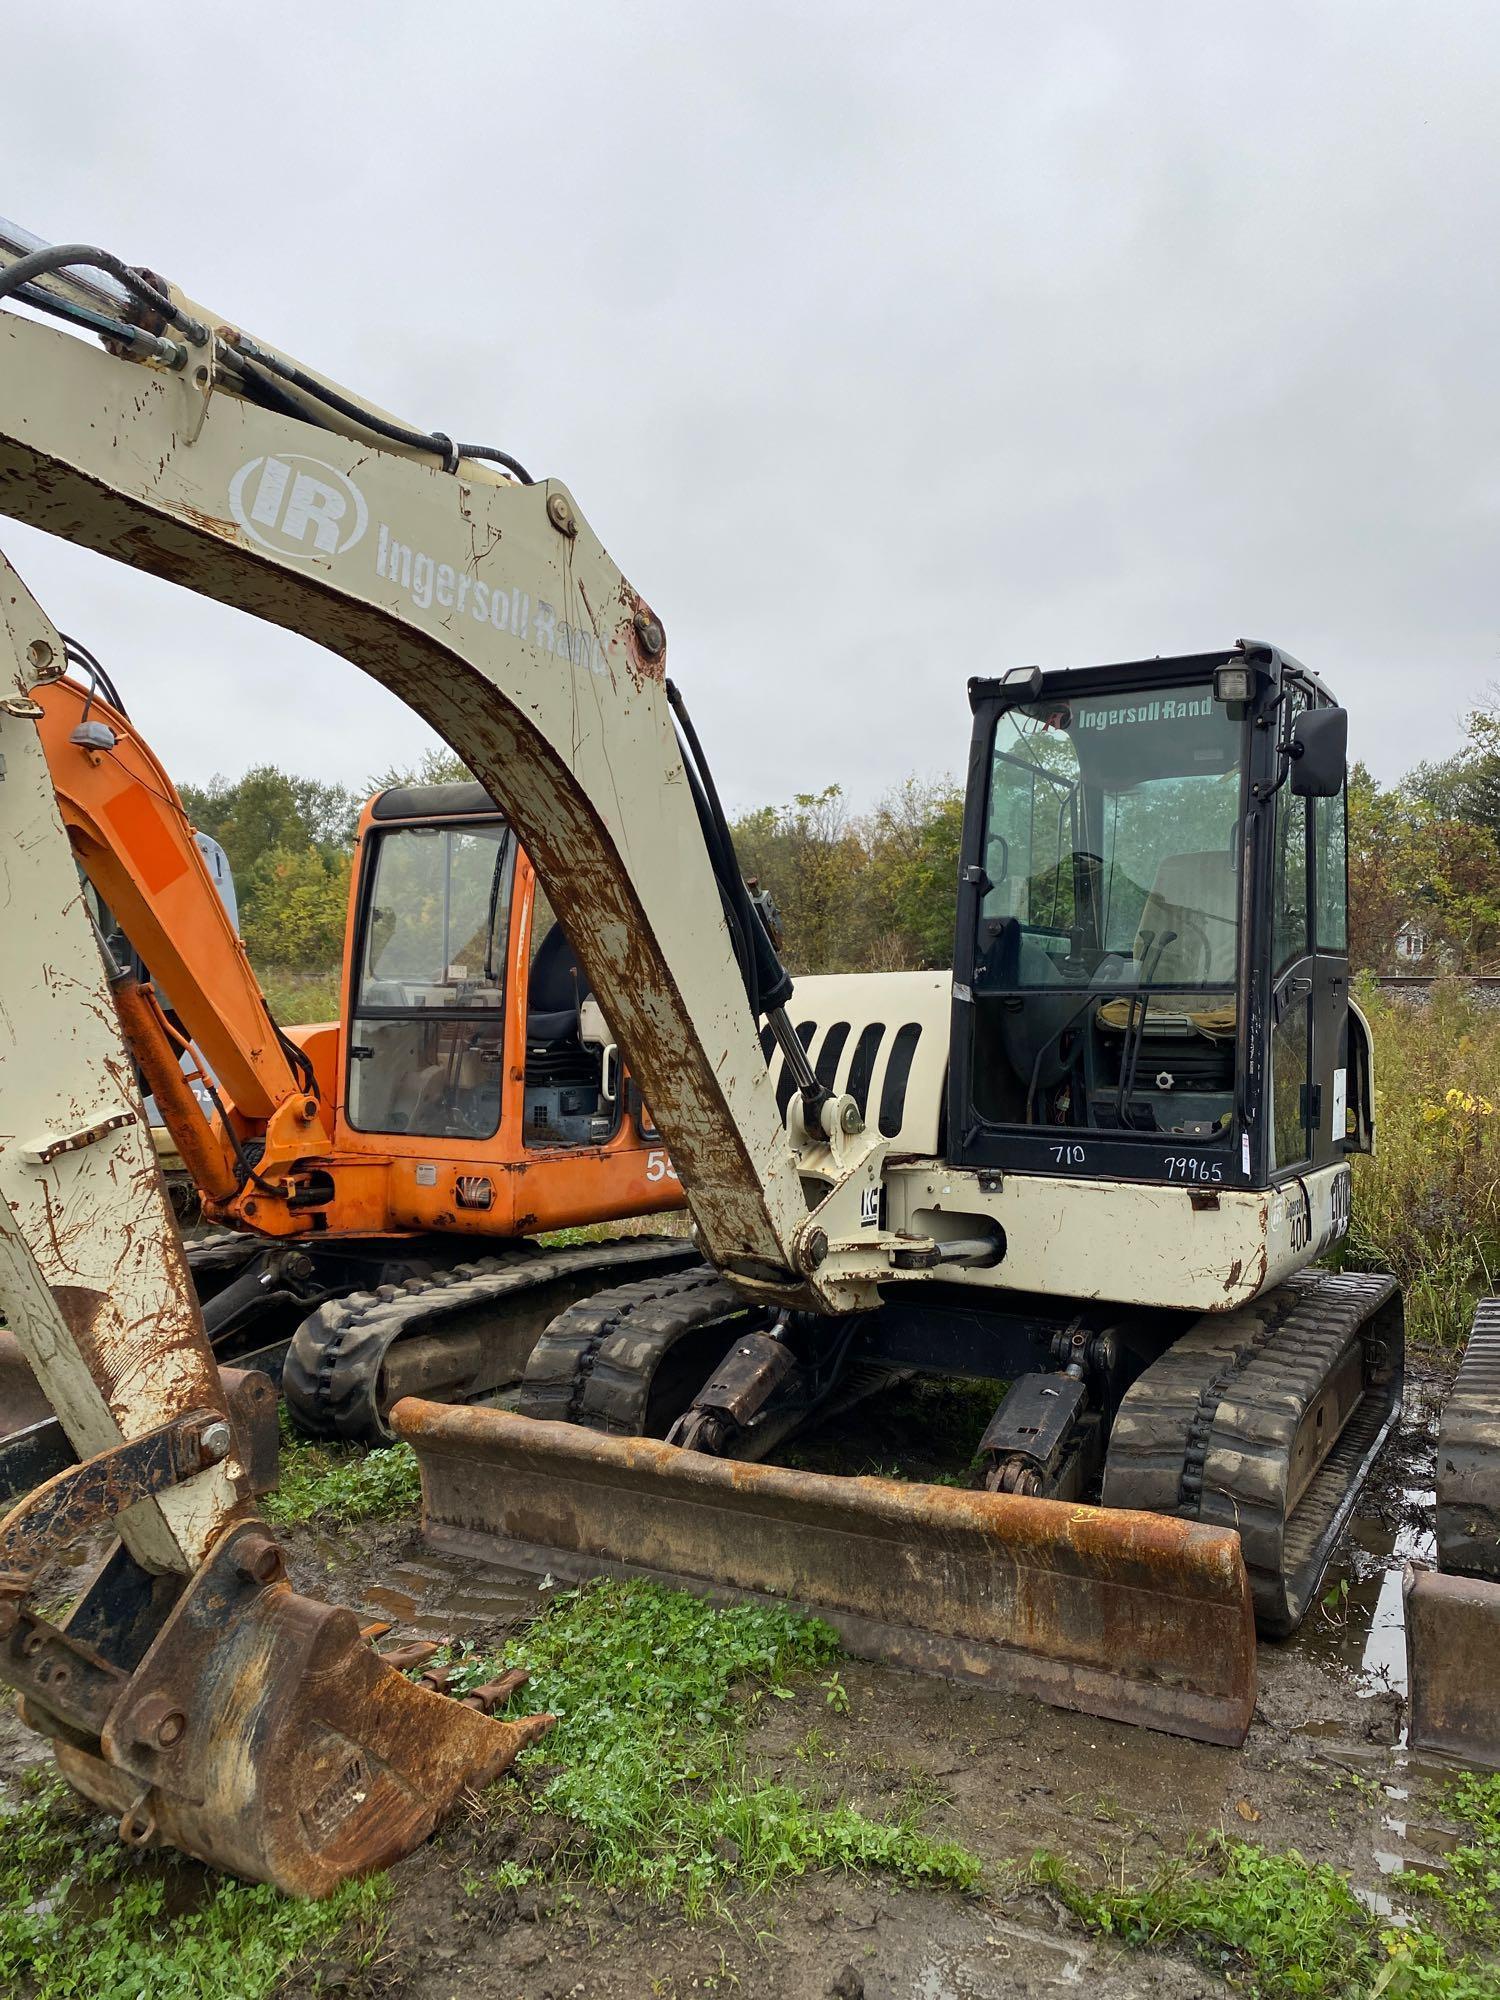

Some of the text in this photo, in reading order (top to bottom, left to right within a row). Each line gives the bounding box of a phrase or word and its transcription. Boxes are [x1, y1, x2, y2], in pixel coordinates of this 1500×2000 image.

[251, 456, 347, 553] IR
[1050, 1145, 1085, 1165] 710
[1163, 1157, 1223, 1182] 79965
